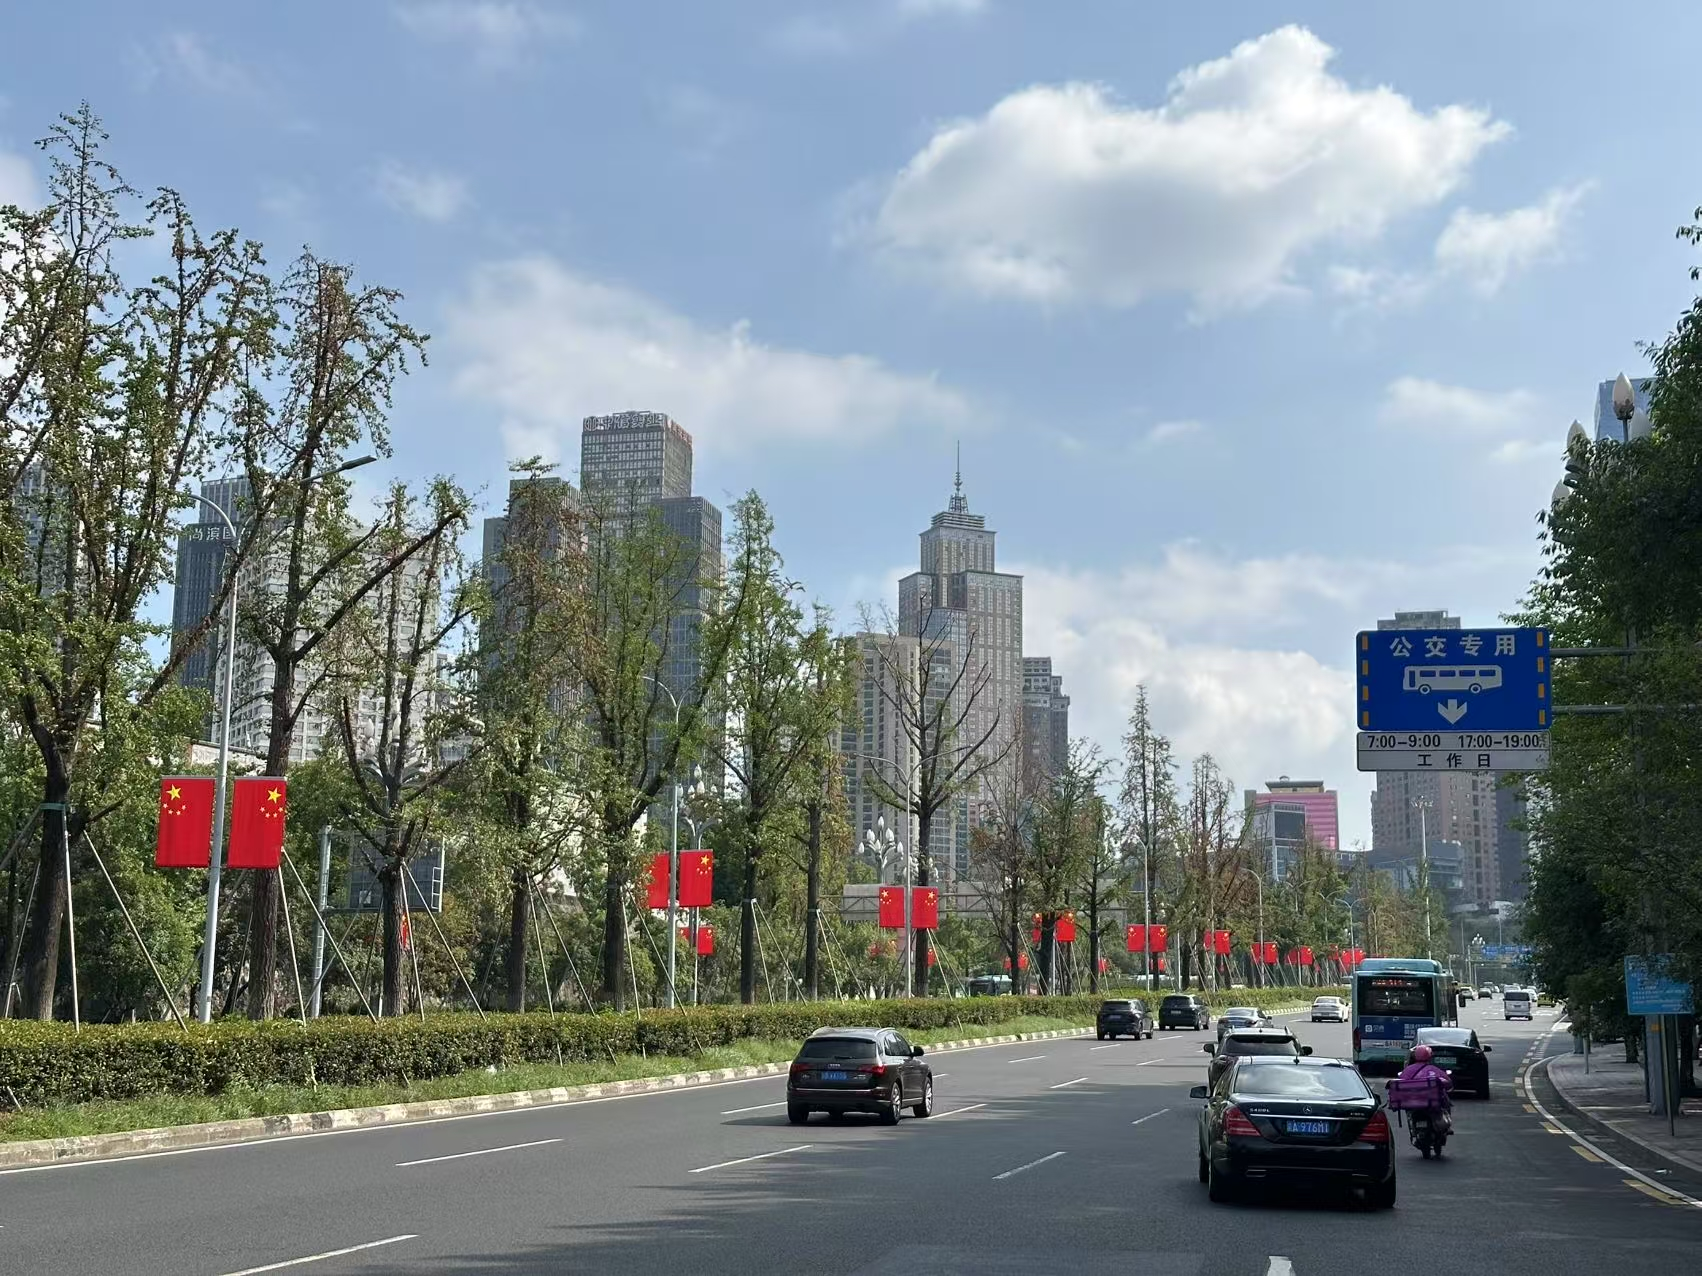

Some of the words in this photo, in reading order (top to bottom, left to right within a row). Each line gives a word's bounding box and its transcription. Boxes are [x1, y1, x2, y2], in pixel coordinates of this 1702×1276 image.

[1389, 634, 1515, 657] 公交专用
[1367, 734, 1441, 748] 7:00-9:00
[1458, 734, 1539, 748] 17:00-19:00
[1417, 753, 1491, 768] 工作日
